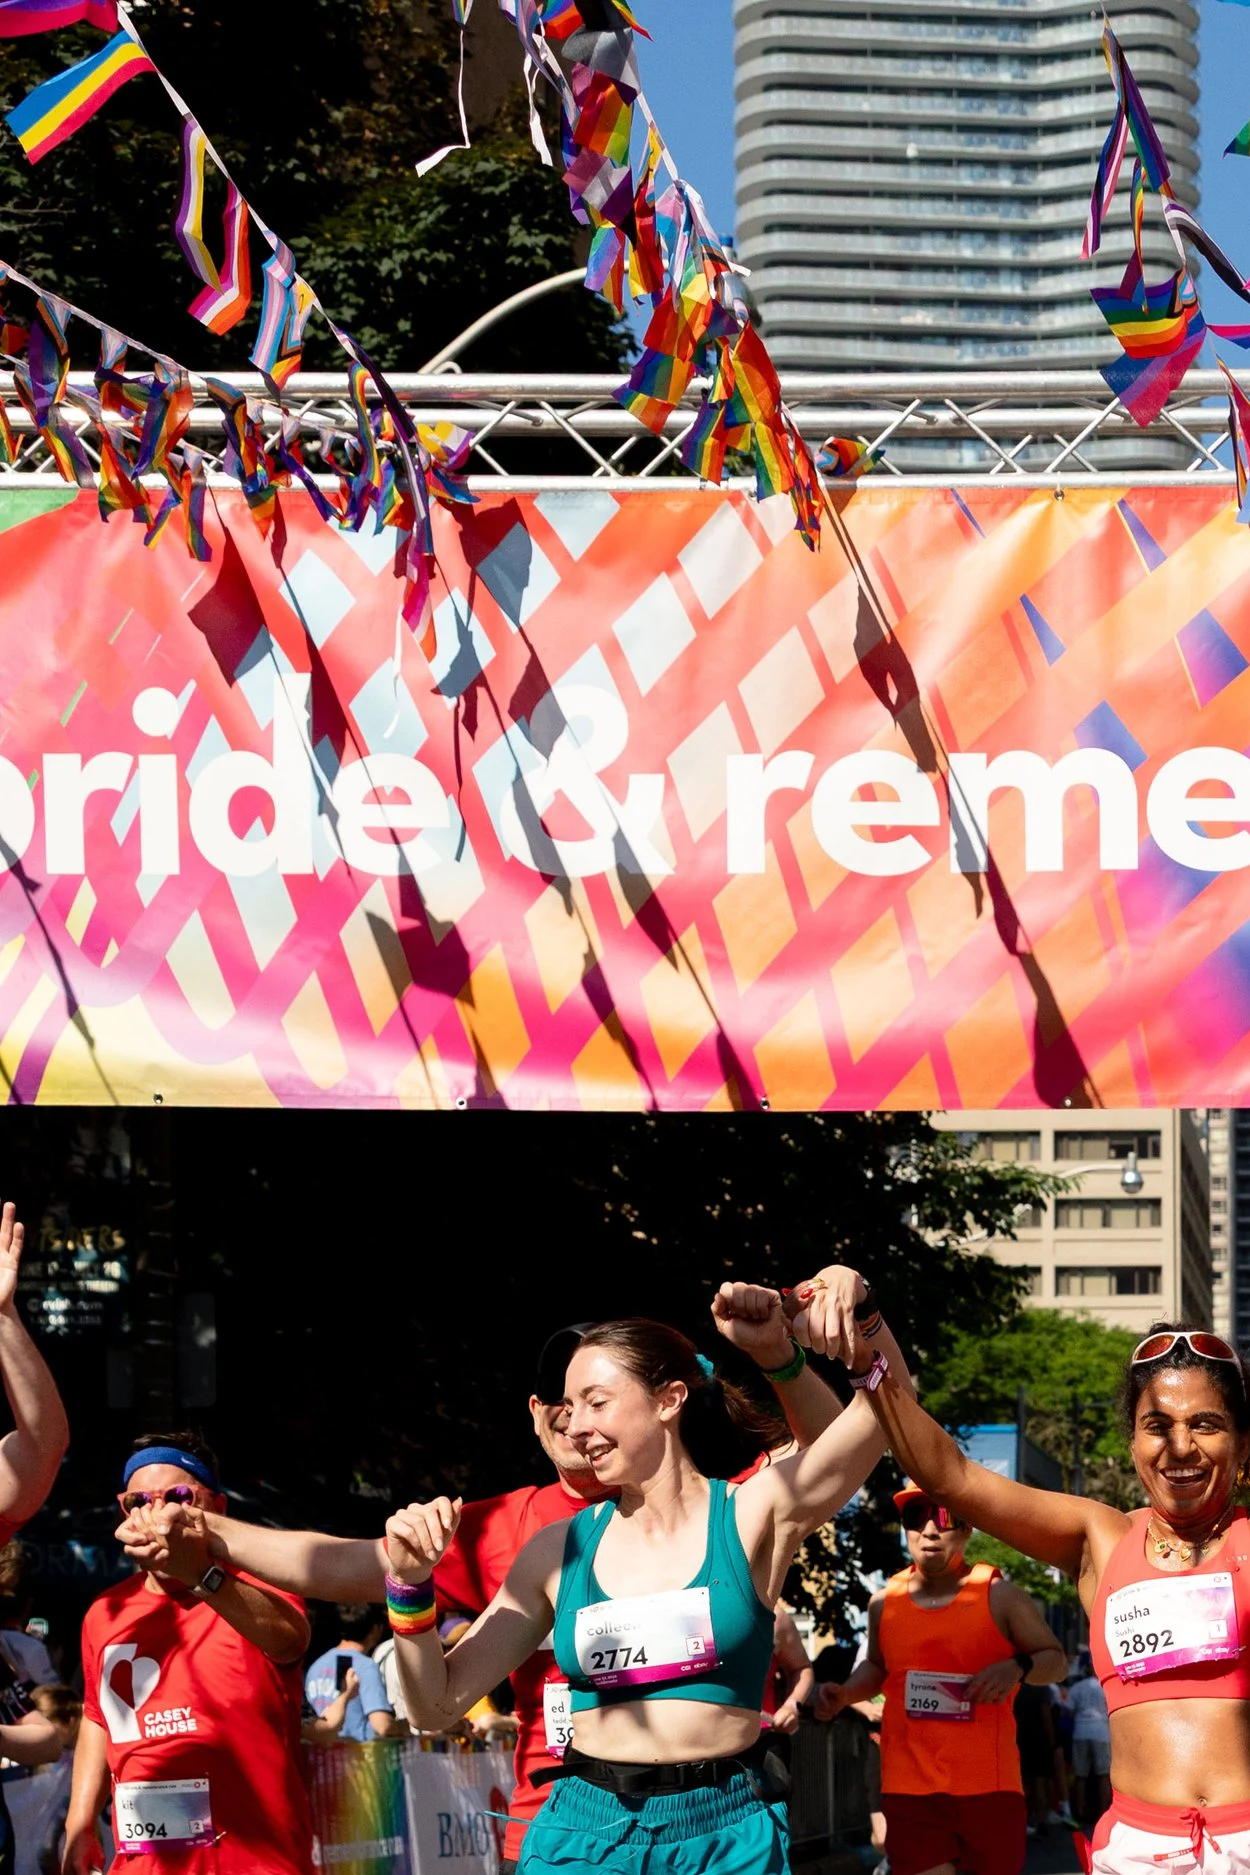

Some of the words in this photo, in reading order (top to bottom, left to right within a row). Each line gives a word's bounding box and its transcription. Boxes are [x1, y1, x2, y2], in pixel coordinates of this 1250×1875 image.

[0, 673, 450, 876] ride
[500, 684, 675, 877] &
[1114, 1605, 1151, 1625] susha
[693, 1641, 700, 1651] 2
[1119, 1629, 1175, 1658] 2892
[590, 1646, 649, 1671] 2774
[911, 1682, 937, 1691] tyrone
[551, 1701, 565, 1713] ed
[911, 1698, 940, 1711] 2169
[144, 1706, 192, 1725] CASEY
[145, 1718, 198, 1738] HOUSE
[556, 1727, 574, 1744] 30
[122, 1800, 134, 1810] kit
[125, 1822, 168, 1839] 3094
[194, 1822, 200, 1831] 2
[437, 1811, 491, 1859] BMO
